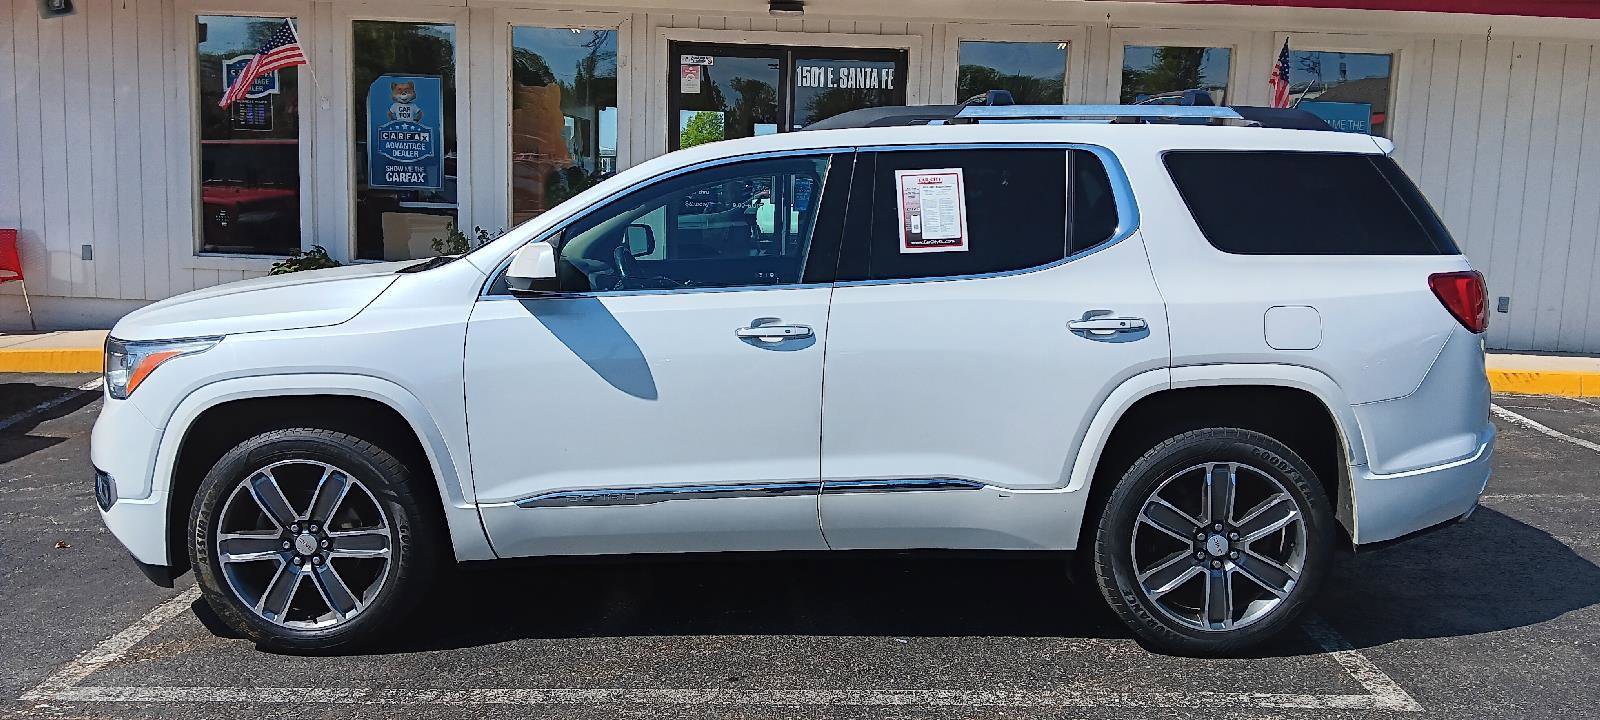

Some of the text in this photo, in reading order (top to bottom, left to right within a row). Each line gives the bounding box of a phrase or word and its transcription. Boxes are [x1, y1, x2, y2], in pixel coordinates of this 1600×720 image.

[797, 66, 895, 89] 1501 E. SANTA FE
[1333, 119, 1346, 129] ME
[1348, 119, 1366, 131] THE
[381, 132, 430, 142] CARFAX
[385, 141, 426, 151] ADVANTAGE
[392, 150, 419, 158] DEALER
[385, 172, 427, 183] CARFAX
